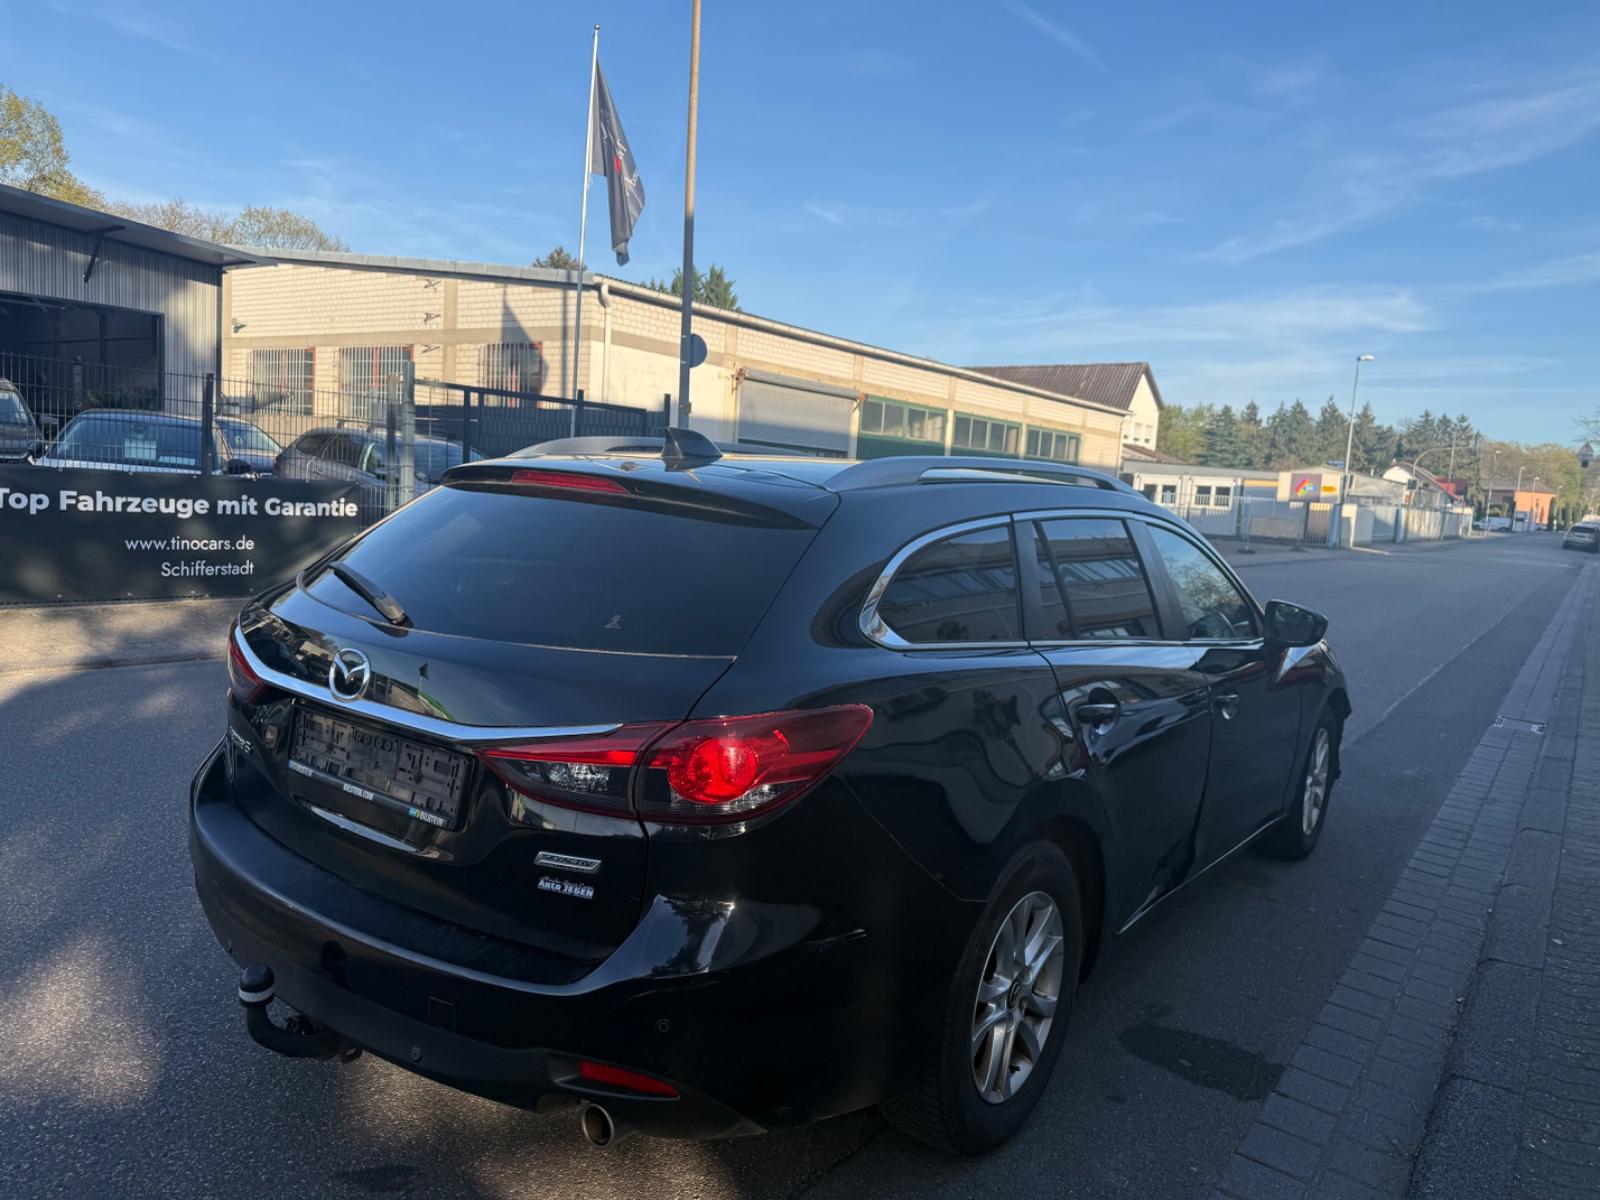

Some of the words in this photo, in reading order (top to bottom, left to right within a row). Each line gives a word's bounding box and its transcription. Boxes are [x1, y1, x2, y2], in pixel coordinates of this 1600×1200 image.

[0, 487, 50, 515] Top
[59, 490, 210, 519] Fahrzeuge
[217, 494, 258, 515] mit
[264, 497, 358, 517] Garantie
[125, 534, 255, 550] www.tinocars.de
[161, 560, 255, 577] Schifferstadt
